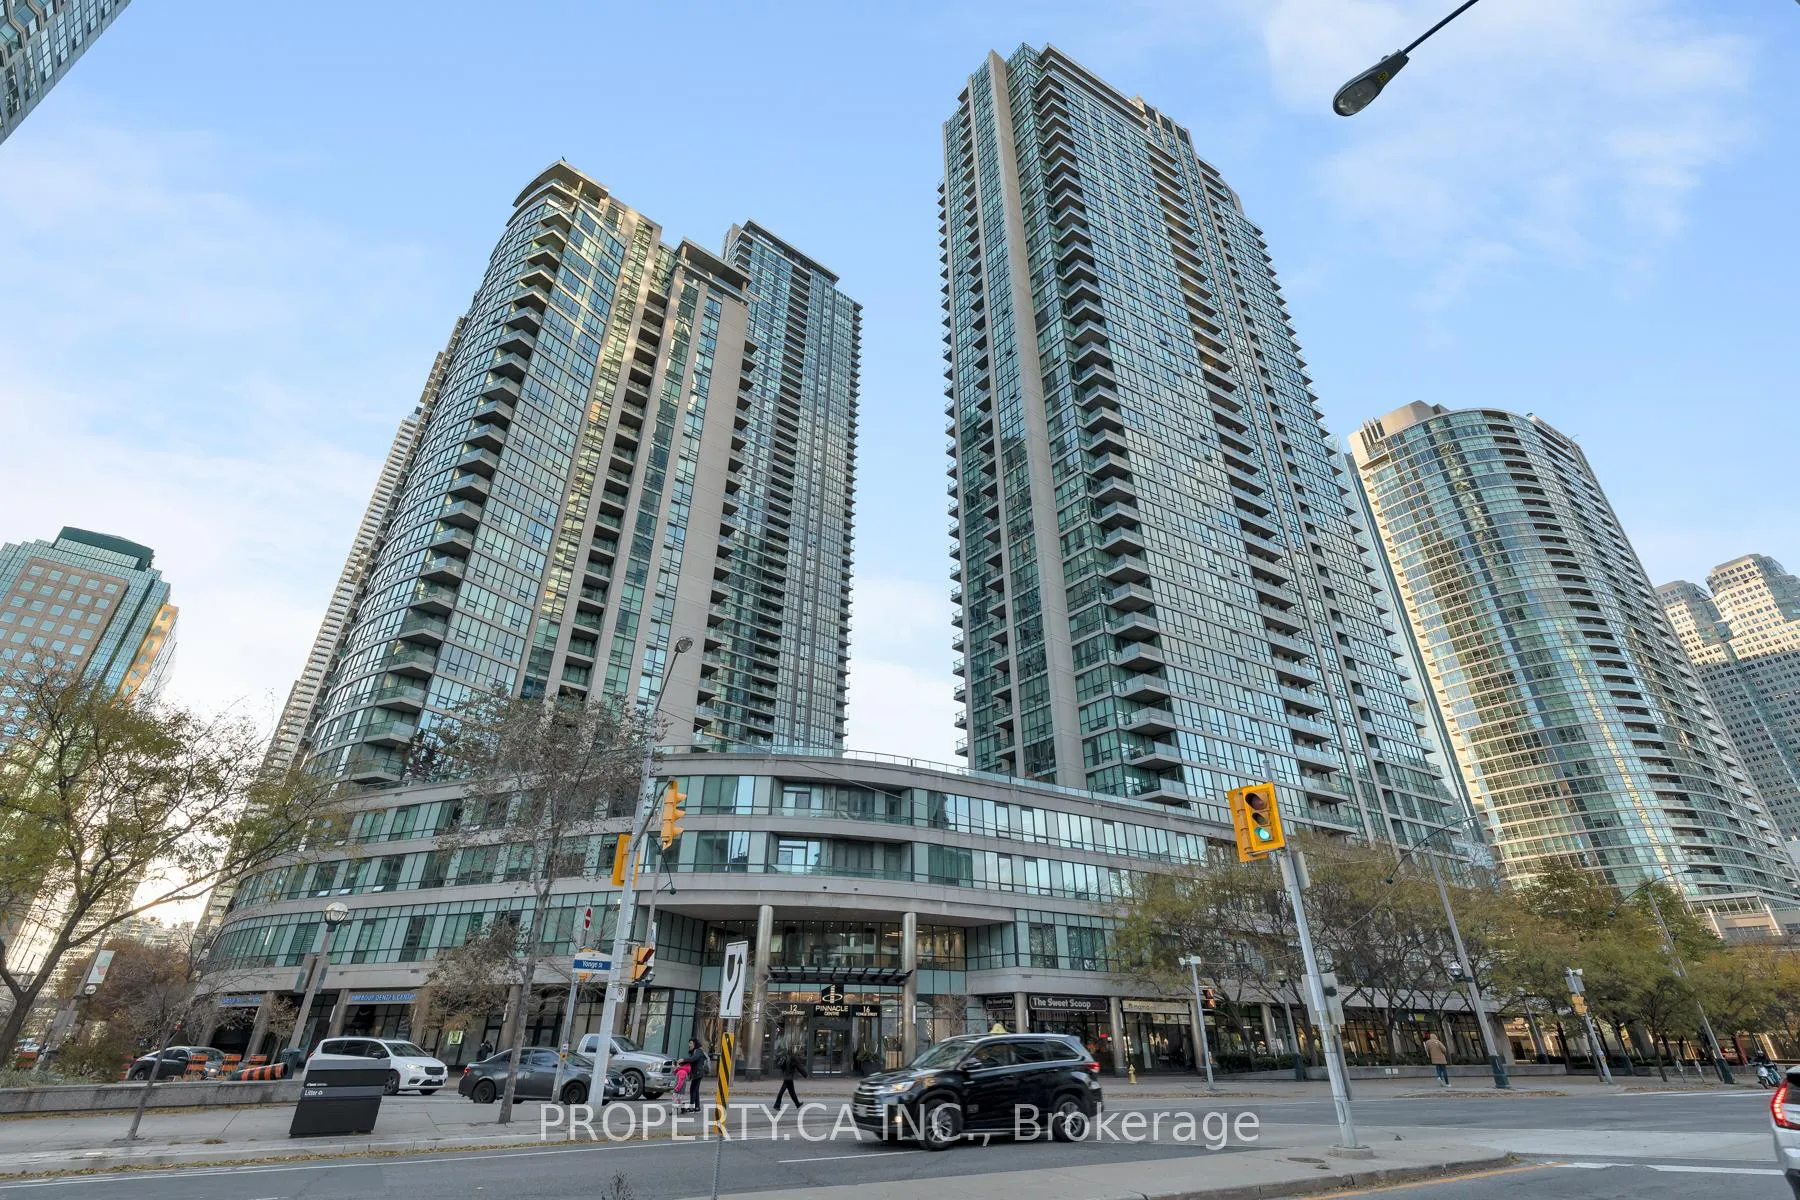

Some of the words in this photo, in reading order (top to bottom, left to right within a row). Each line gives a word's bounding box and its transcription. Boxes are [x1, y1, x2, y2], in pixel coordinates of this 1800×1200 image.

[1033, 998, 1046, 1006] The
[1048, 998, 1068, 1007] Sweet
[1069, 999, 1091, 1009] Scoop
